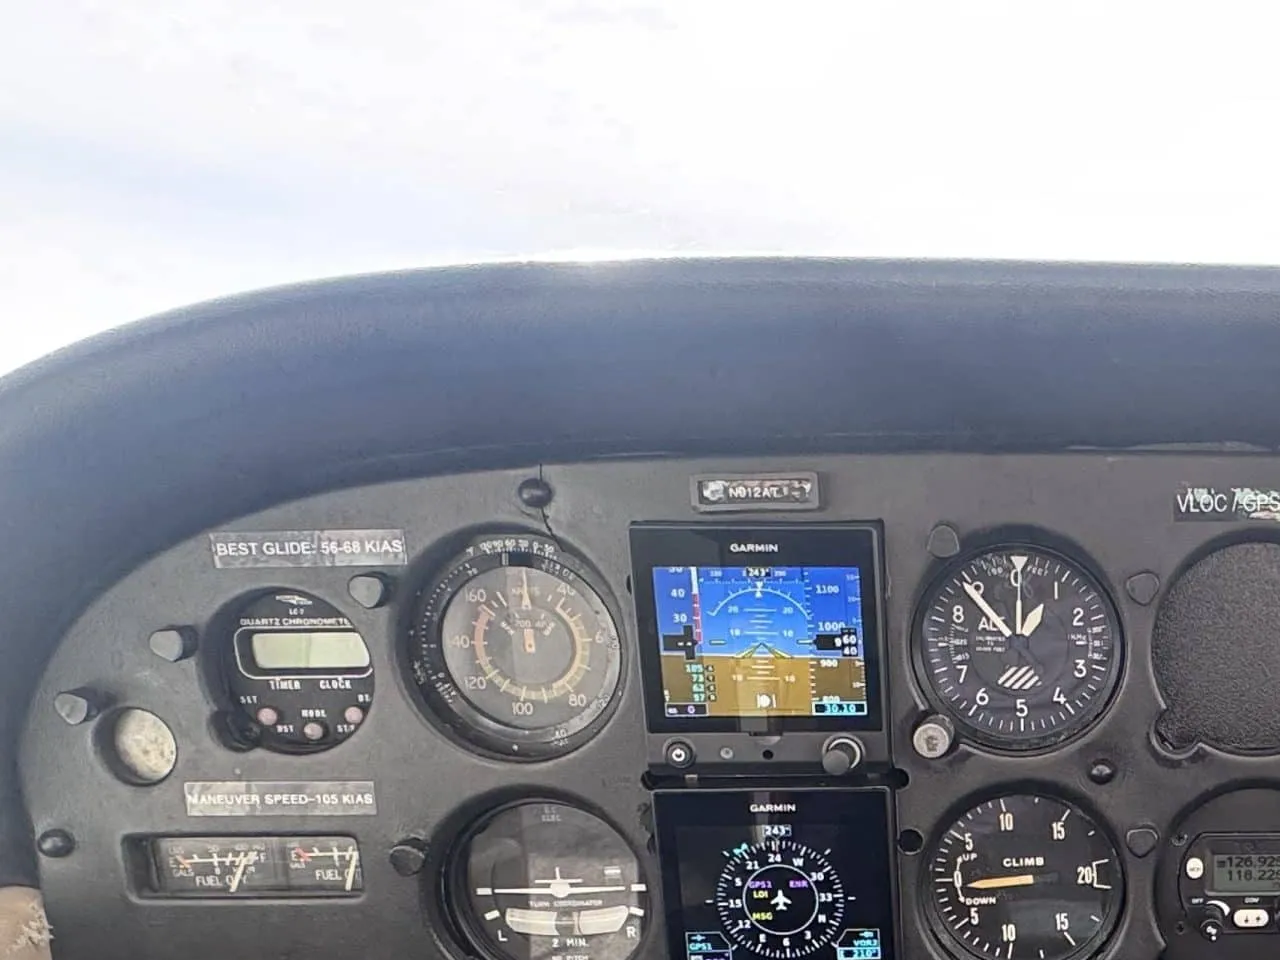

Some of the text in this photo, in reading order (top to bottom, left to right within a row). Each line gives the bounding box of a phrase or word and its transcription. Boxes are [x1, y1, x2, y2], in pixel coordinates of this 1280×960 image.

[1243, 494, 1280, 512] GPS
[216, 540, 403, 557] BEST GLIDE: 56-68 KIAS
[730, 543, 778, 553] GARMIN
[673, 613, 687, 623] 30
[952, 605, 964, 623] 8
[1073, 608, 1084, 627] 2
[282, 618, 350, 626] CHRONOMETE
[956, 665, 968, 683] 7
[1074, 659, 1086, 678] 3
[269, 680, 301, 690] TIMER
[320, 679, 352, 690] CLOCK
[464, 677, 487, 690] 120
[569, 695, 587, 707] 80
[976, 688, 989, 705] 6
[1053, 687, 1067, 704] 4
[511, 703, 534, 715] 100
[1016, 699, 1029, 717] 5
[187, 795, 260, 806] MANEUVER
[342, 794, 373, 805] KIAS
[750, 804, 796, 813] GARMIN
[1000, 813, 1014, 831] 10
[1053, 822, 1065, 840] 15
[965, 833, 974, 850] 5
[768, 854, 781, 863] 24
[792, 858, 804, 867] W
[1003, 857, 1045, 868] CLIMB
[196, 875, 222, 887] FUEL
[315, 869, 342, 881] FUEL
[811, 872, 824, 881] 30
[1077, 867, 1093, 884] 20
[729, 899, 742, 908] 15
[819, 893, 833, 902] 33
[966, 897, 996, 905] DOWN
[752, 912, 773, 921] MSG
[970, 908, 979, 925] 5
[1056, 913, 1069, 930] 15
[498, 930, 508, 941] L
[627, 926, 636, 937] R
[1002, 924, 1016, 942] 10
[552, 938, 560, 947] 2
